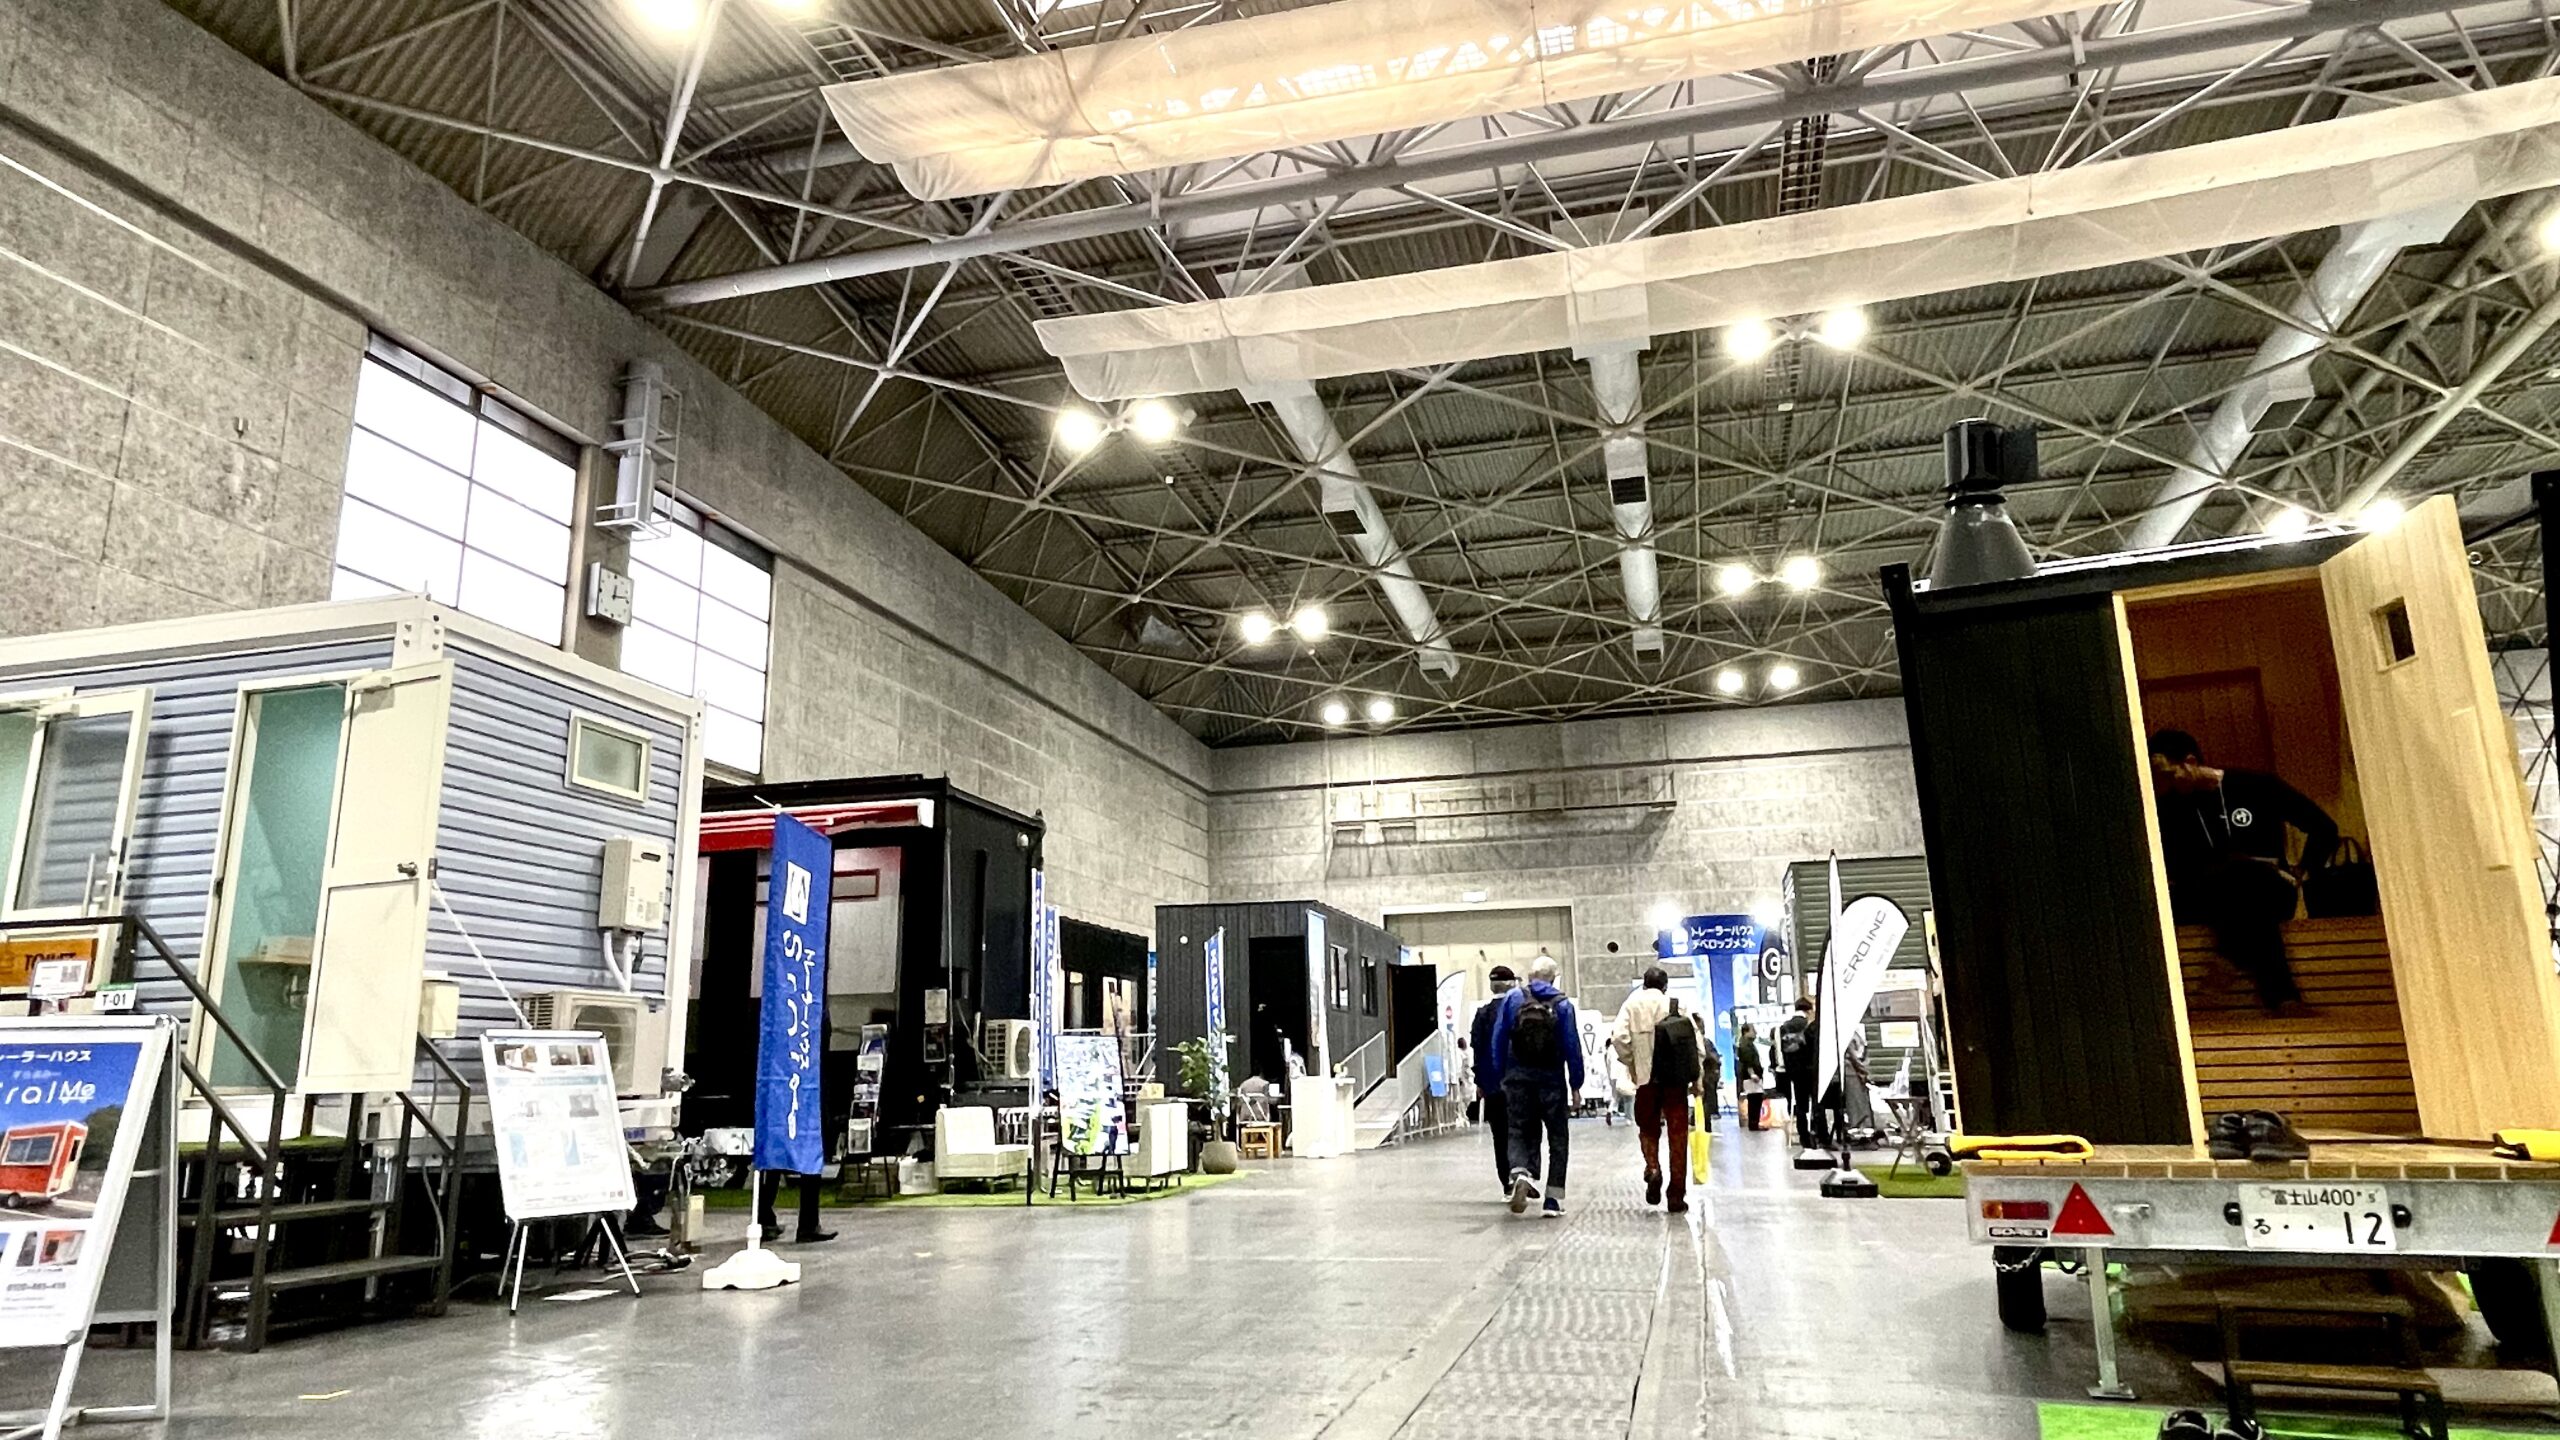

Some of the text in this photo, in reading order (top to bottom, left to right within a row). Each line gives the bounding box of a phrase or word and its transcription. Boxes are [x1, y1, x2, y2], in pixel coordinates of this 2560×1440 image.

[1691, 925, 1755, 936] トレーラーハウス
[102, 993, 127, 1007] T-01
[2253, 1211, 2386, 1246] る 12
